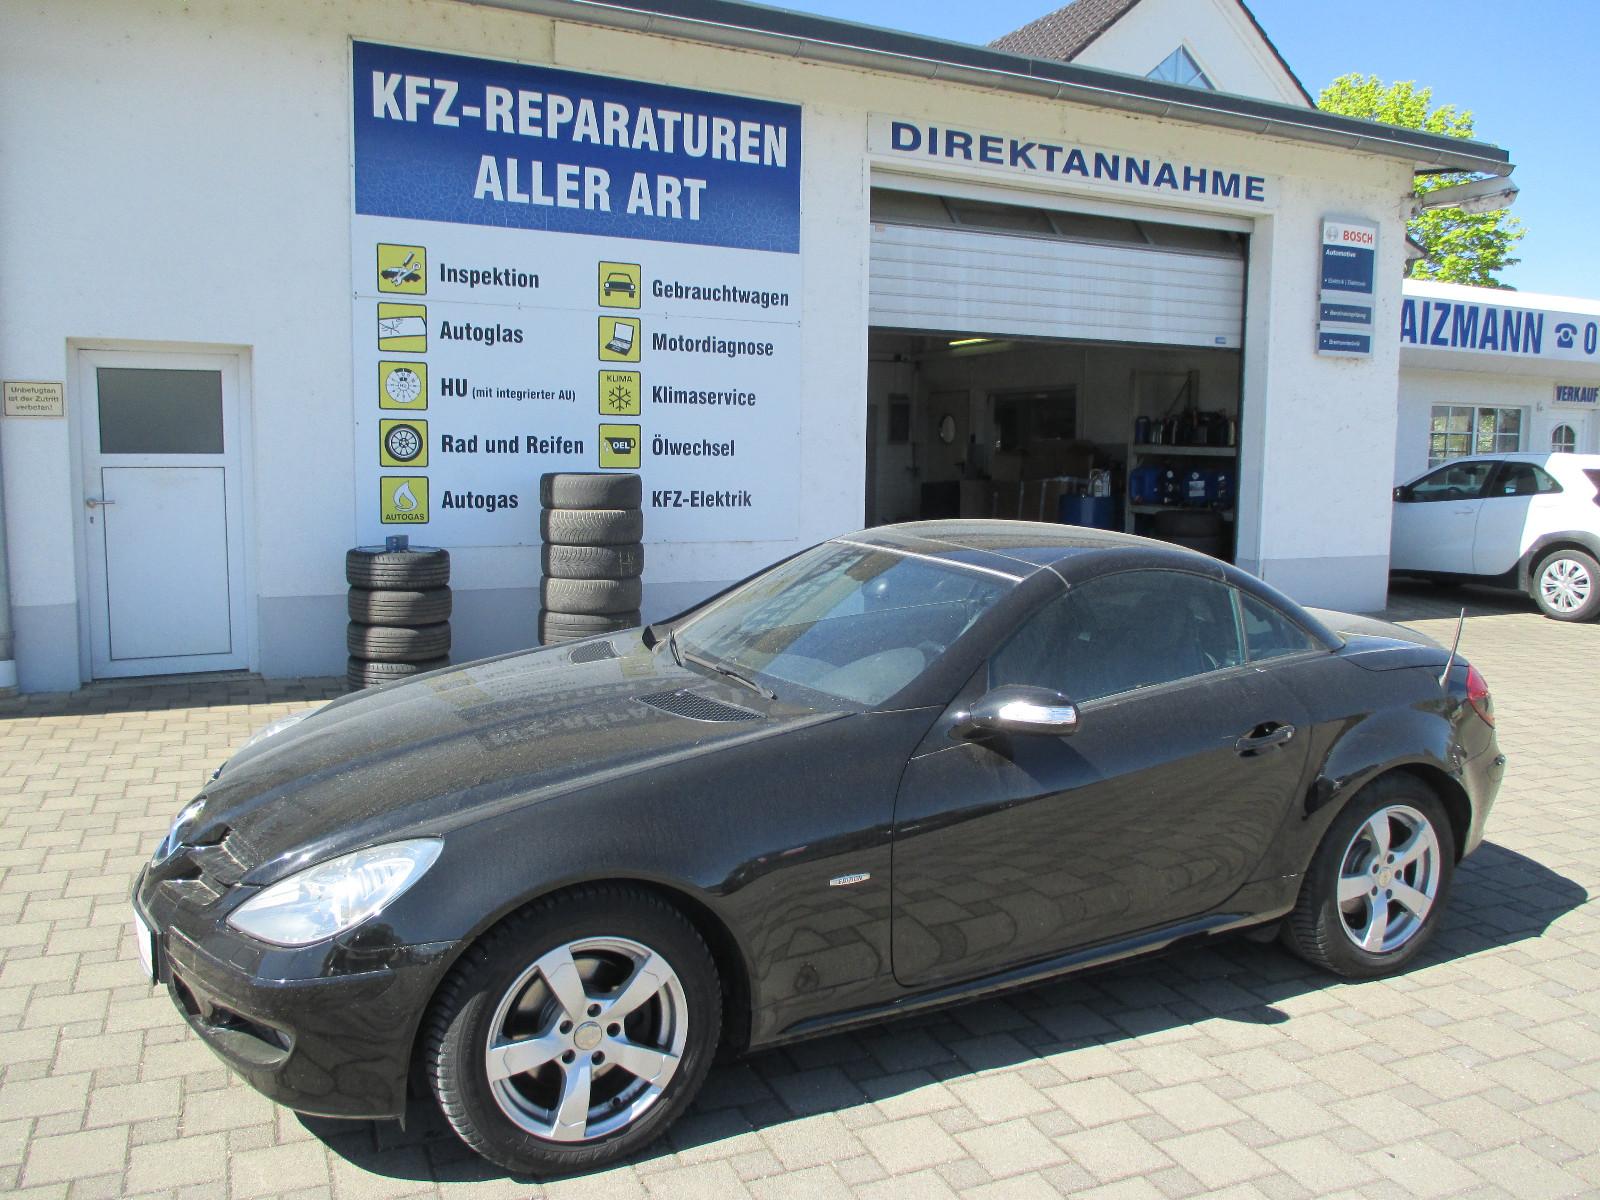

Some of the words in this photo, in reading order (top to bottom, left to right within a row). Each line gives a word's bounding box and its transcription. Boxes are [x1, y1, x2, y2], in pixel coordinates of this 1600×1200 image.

[372, 70, 788, 168] KFZ-REPARATUREN
[891, 121, 1265, 201] DIREKTANNAHME
[473, 154, 611, 212] ALLER
[626, 172, 707, 221] ART
[1343, 230, 1373, 244] BOSCH
[439, 263, 540, 288] Inspektion
[652, 279, 789, 308] Gebrauchtwagen
[439, 320, 524, 346] Autoglas
[652, 333, 774, 358] Motordiagnose
[440, 377, 468, 397] HU
[472, 386, 493, 400] (mit
[496, 387, 556, 401] integrierter
[558, 391, 576, 403] AU)
[606, 374, 633, 383] KLIMA
[652, 386, 756, 407] Klimaservice
[1556, 385, 1600, 403] VERKAUF
[441, 434, 478, 454] Rad
[485, 435, 519, 454] und
[526, 435, 584, 454] Reifen
[612, 441, 631, 450] OEL
[652, 433, 735, 457] Ölwechsel
[441, 490, 519, 512] Autogas
[652, 490, 752, 508] KFZ-Elektrik
[385, 512, 425, 522] AUTOGAS
